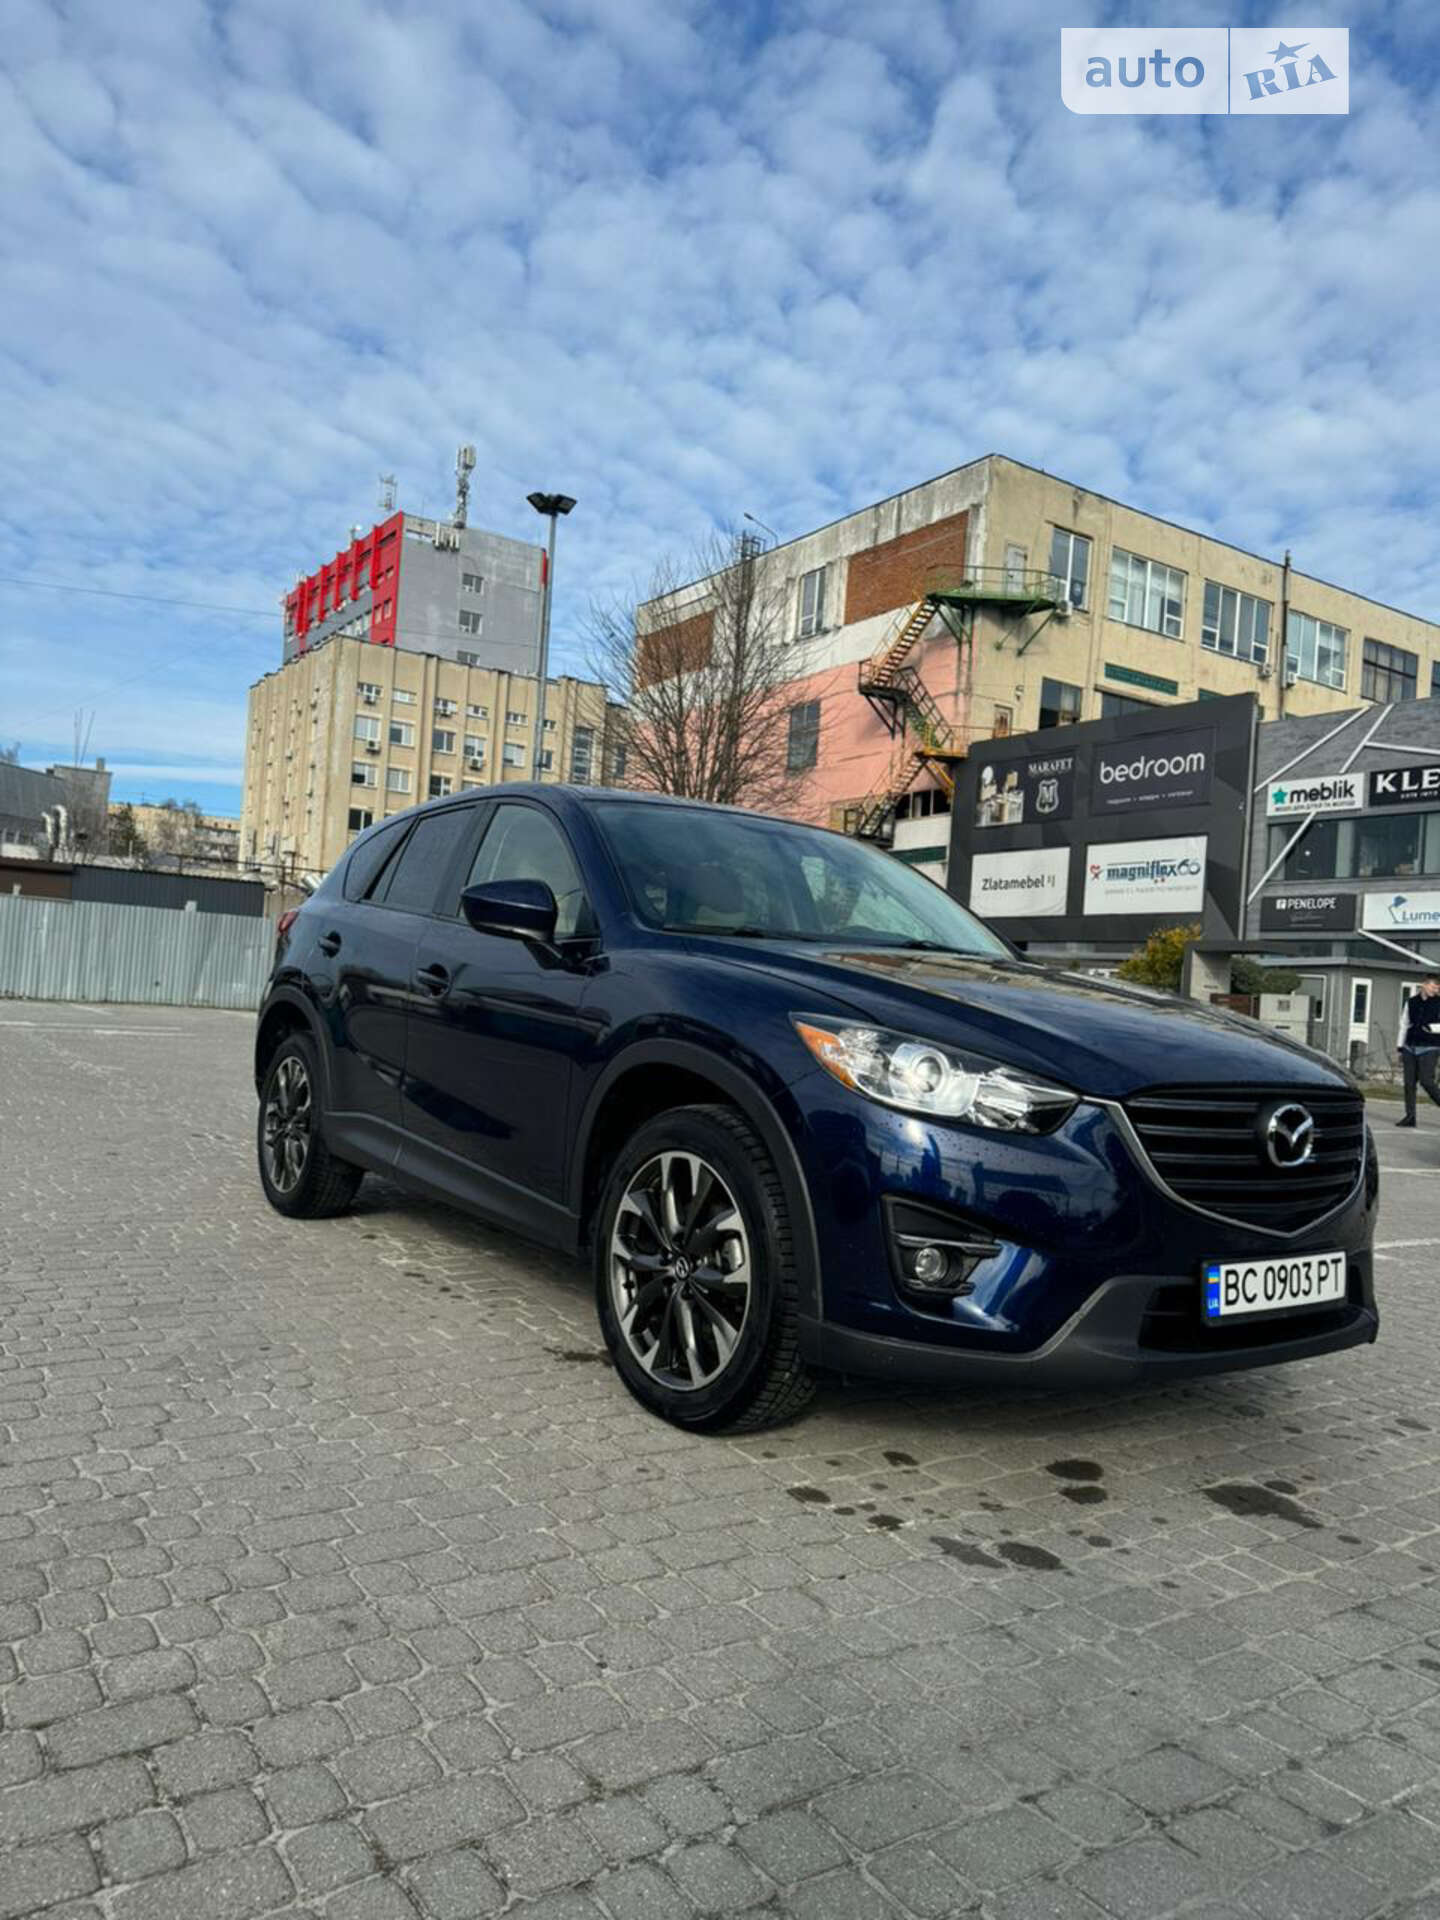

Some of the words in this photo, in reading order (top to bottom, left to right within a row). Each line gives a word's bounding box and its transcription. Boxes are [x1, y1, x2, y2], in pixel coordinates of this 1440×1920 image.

[1100, 752, 1205, 784] bedroom
[1290, 779, 1355, 804] meblik
[1376, 768, 1440, 794] KLE
[982, 874, 1045, 891] Zlatamebel
[1287, 897, 1337, 910] PENELOPE
[1224, 1268, 1258, 1307] BC
[1264, 1260, 1313, 1302] 0903
[1317, 1257, 1342, 1296] PT
[1207, 1297, 1219, 1310] UA
